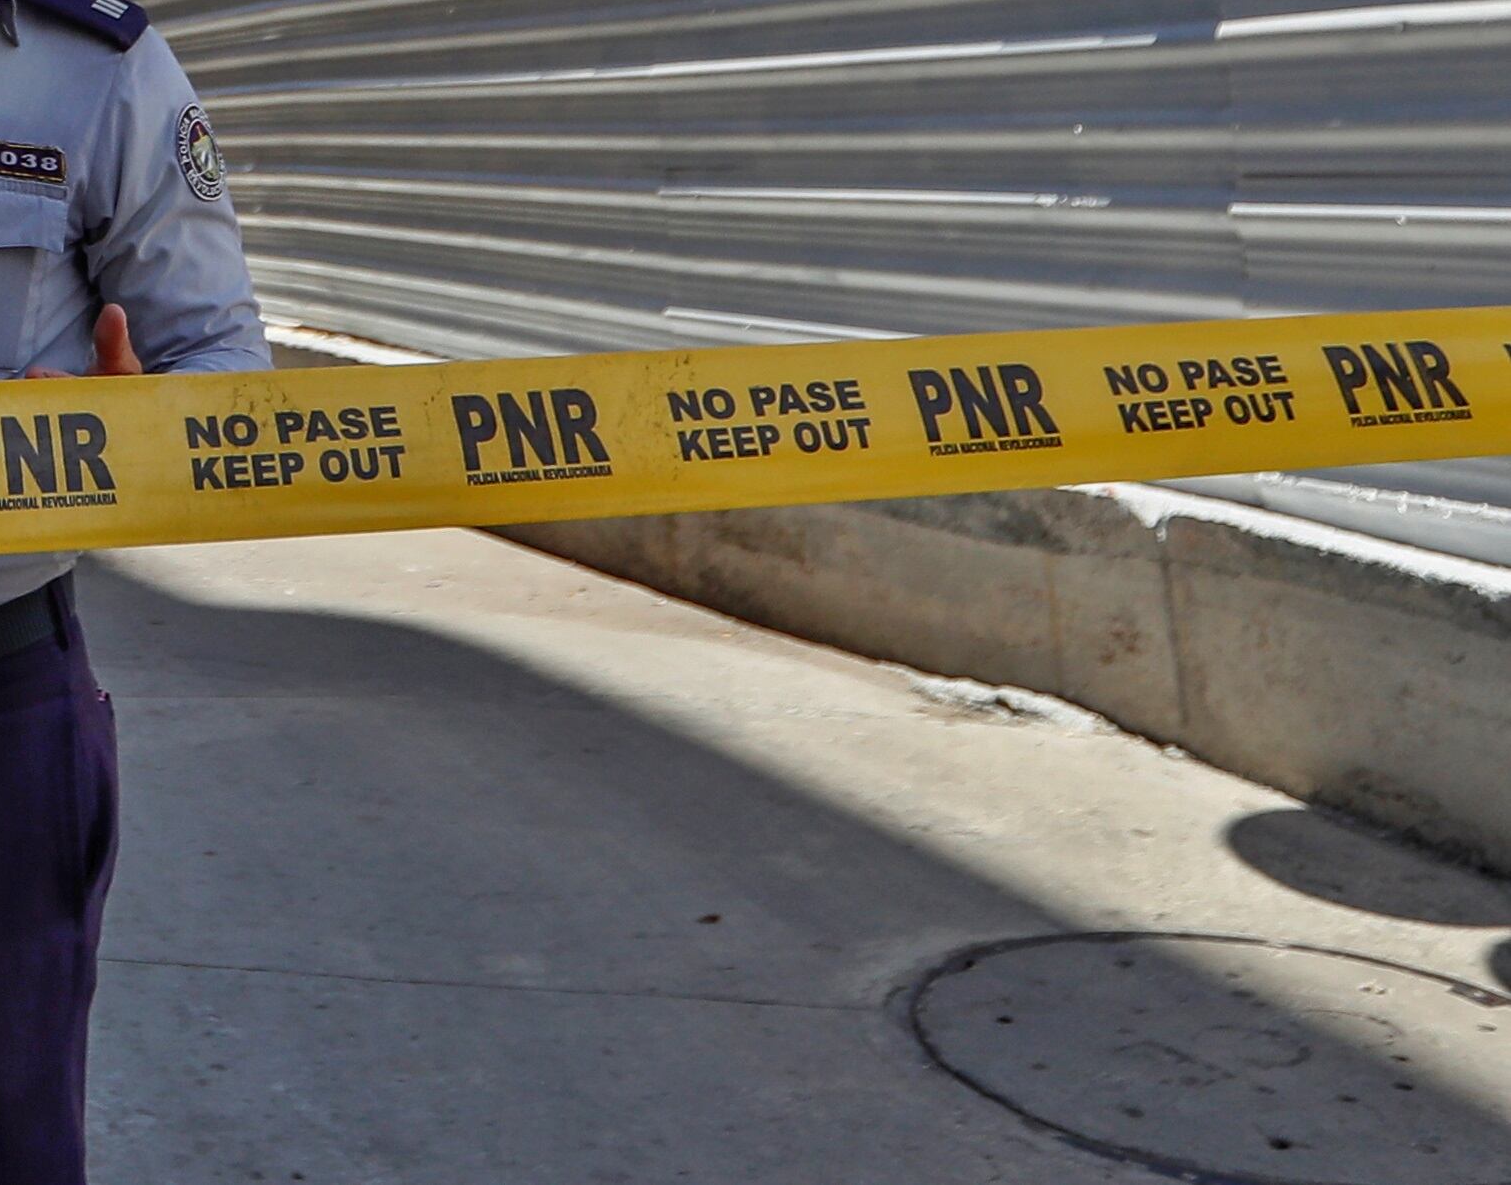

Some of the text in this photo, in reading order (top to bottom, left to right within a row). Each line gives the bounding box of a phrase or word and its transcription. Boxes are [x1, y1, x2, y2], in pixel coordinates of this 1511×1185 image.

[1104, 356, 1287, 395] NO PASE
[1322, 341, 1469, 414] PNR
[667, 380, 865, 422] NO PASE
[908, 364, 1059, 442] PNR
[1118, 392, 1294, 433] KEEP OUT
[185, 407, 401, 448] NO PASE
[451, 389, 610, 471] PNR
[677, 418, 870, 461] KEEP OUT
[192, 445, 405, 490] KEEP OUT
[467, 466, 612, 486] POLICIA NACIONAL REVOLUCIONARIA
[42, 493, 117, 508] REVOLUCIONARIA
